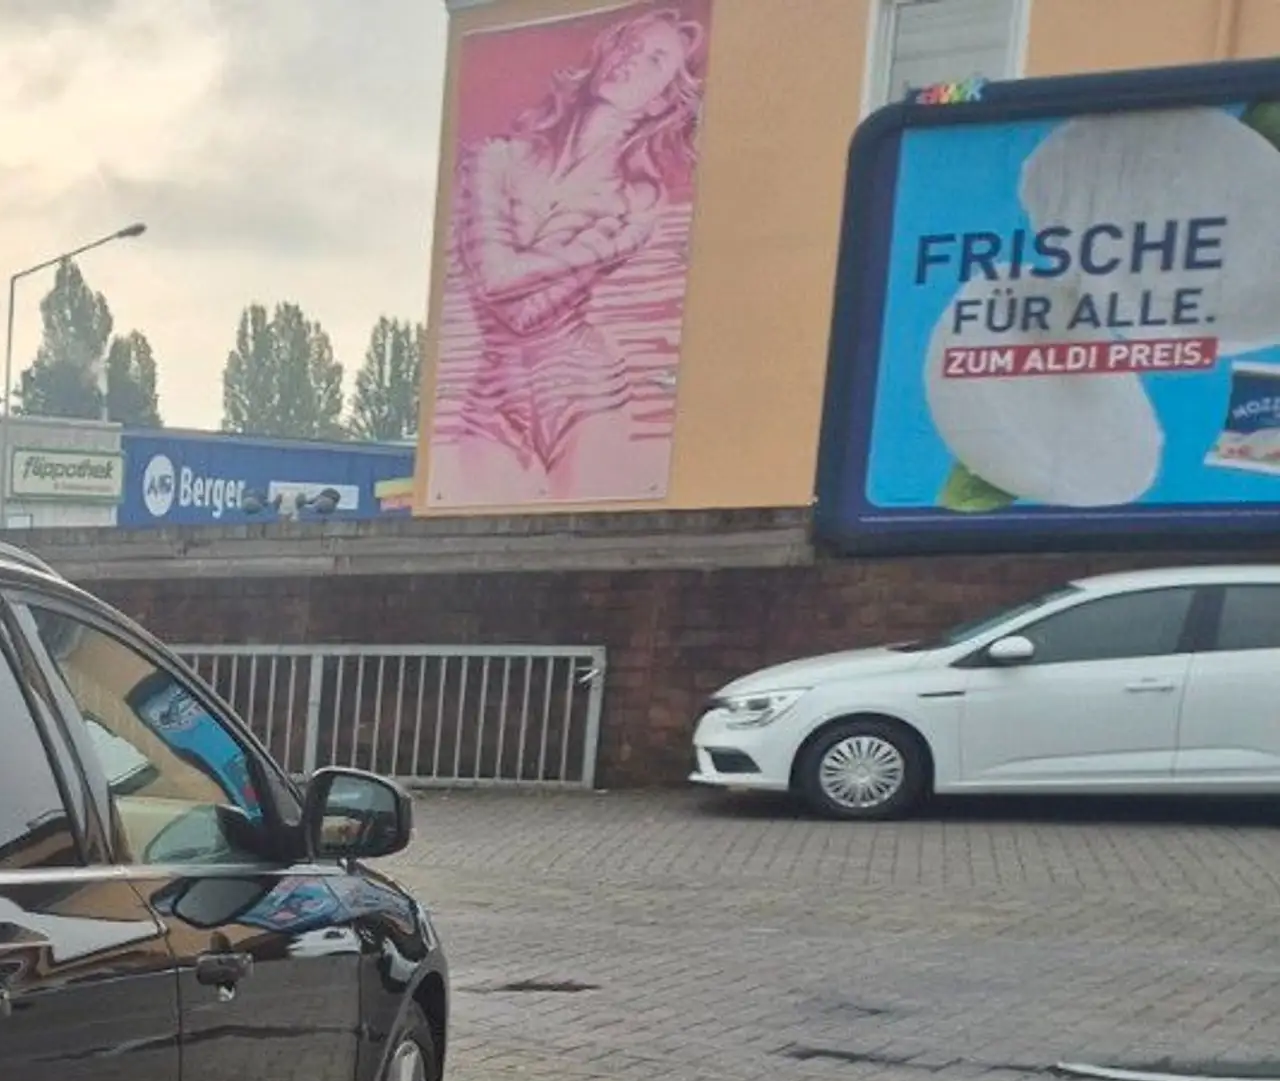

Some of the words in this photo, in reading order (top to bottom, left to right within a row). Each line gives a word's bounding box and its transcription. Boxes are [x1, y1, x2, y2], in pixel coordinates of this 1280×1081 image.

[914, 216, 1228, 285] FRISCHE
[952, 288, 1052, 334] FÜR
[1066, 287, 1216, 330] ALLE.
[946, 350, 1013, 376] ZUM
[1023, 346, 1097, 373] ALDI
[1107, 340, 1211, 368] PREIS.
[180, 466, 246, 518] Berger
